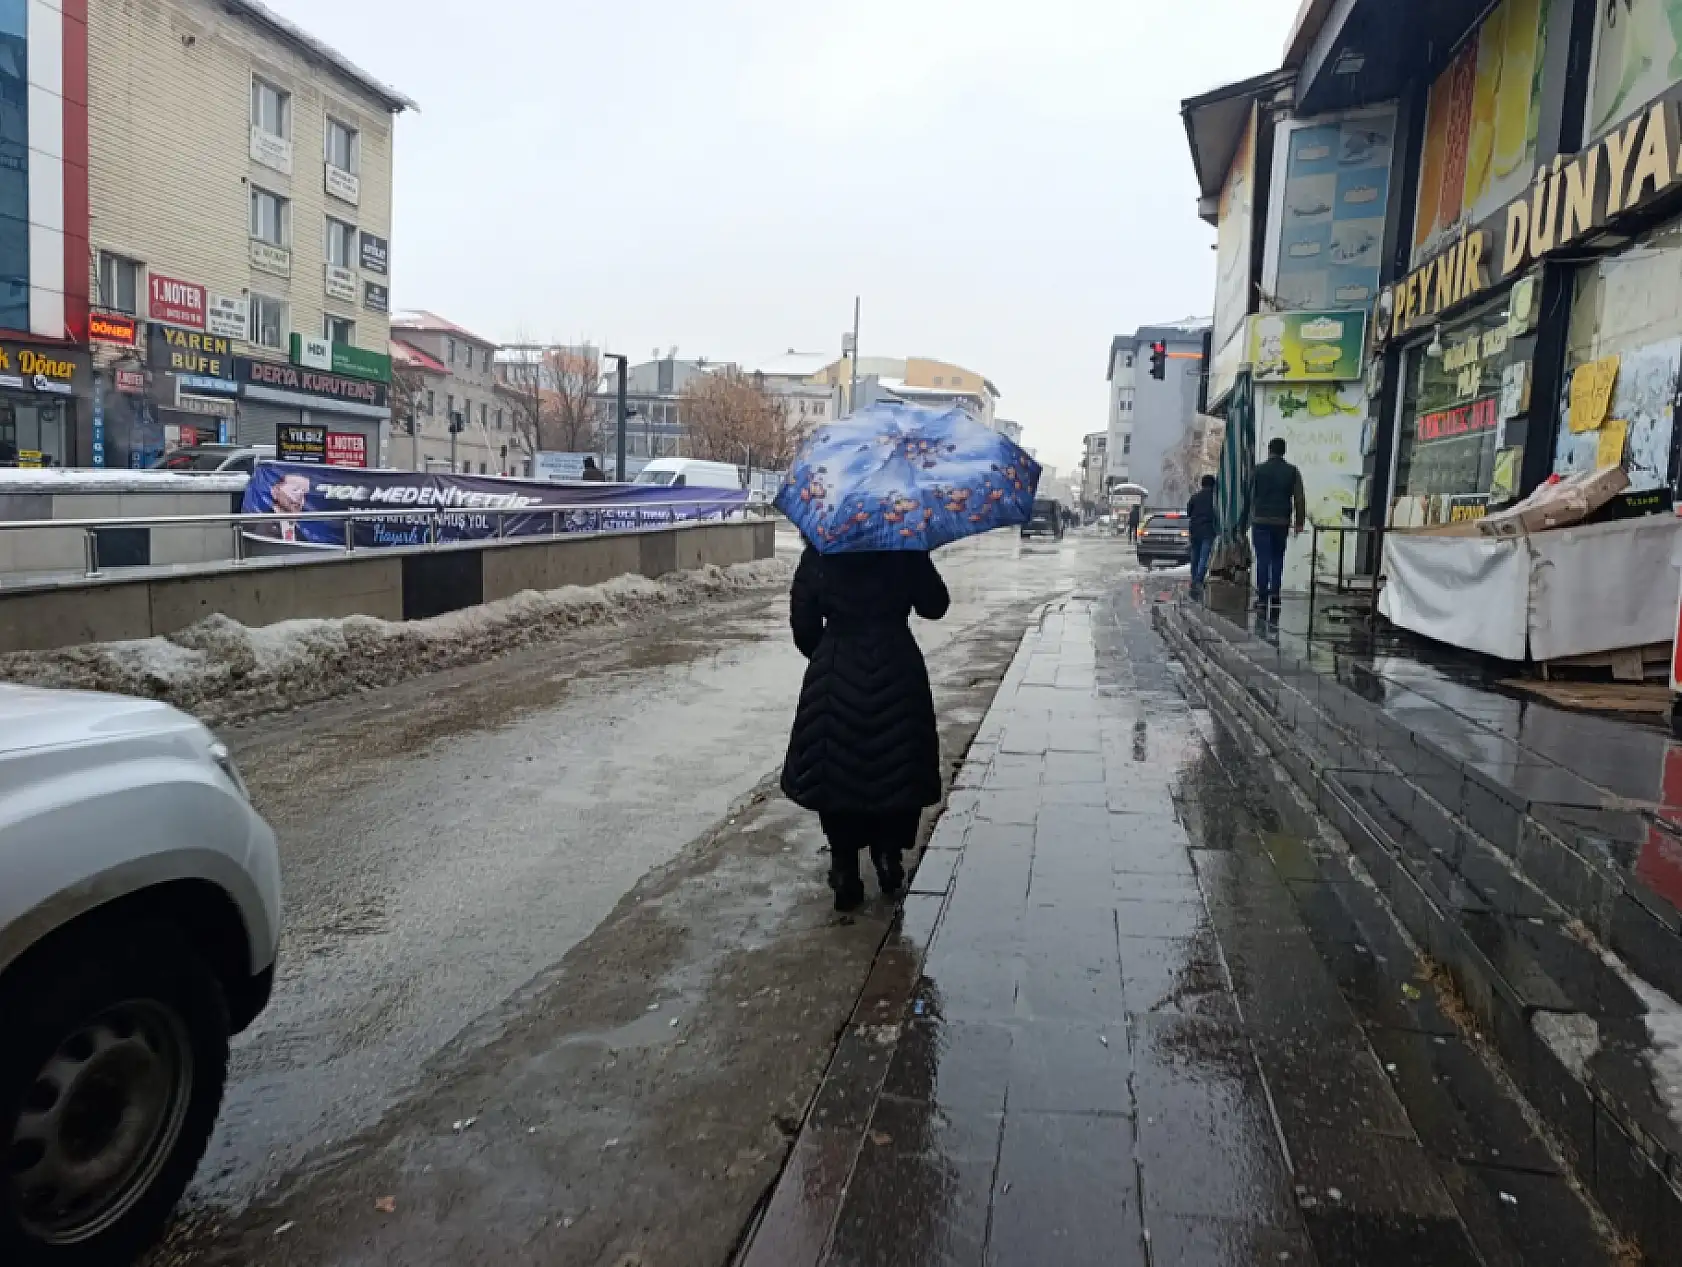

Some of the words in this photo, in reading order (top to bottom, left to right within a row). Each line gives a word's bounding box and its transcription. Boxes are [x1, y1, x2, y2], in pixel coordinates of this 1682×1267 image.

[1391, 222, 1484, 338] PEYNİR
[1503, 101, 1682, 274] DÜNYA
[151, 278, 201, 309] 1.NOTER
[92, 320, 132, 338] DÖNER
[164, 328, 226, 355] YAREN
[18, 350, 76, 379] Döner
[172, 347, 220, 376] BÜFE
[252, 362, 299, 387] DERYA
